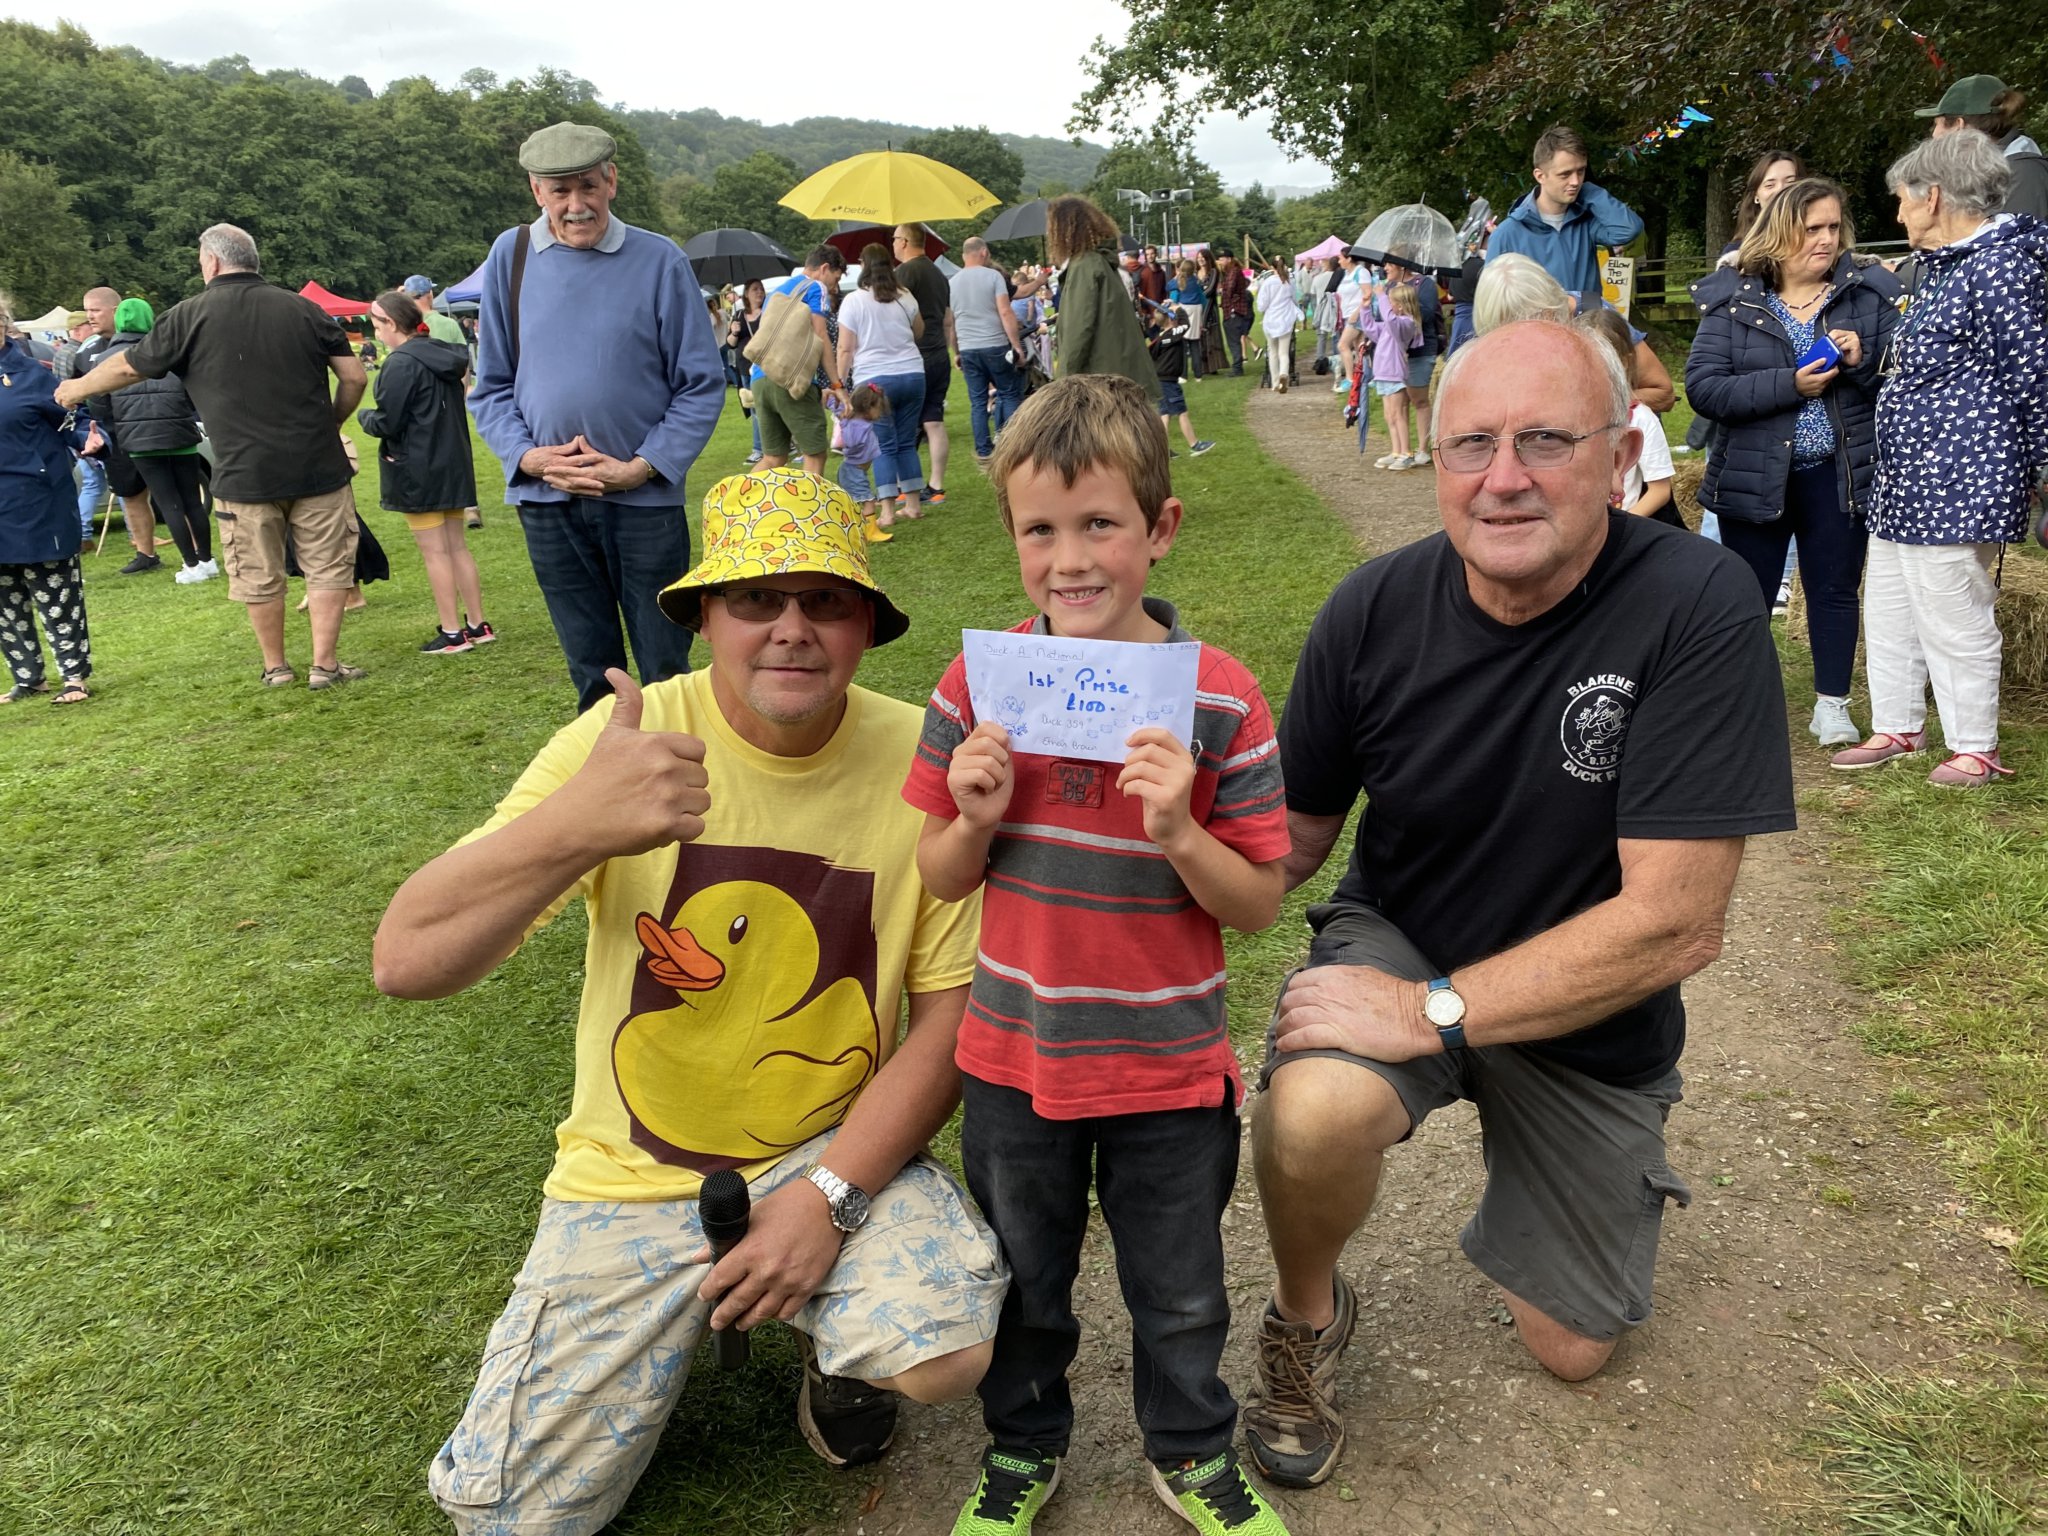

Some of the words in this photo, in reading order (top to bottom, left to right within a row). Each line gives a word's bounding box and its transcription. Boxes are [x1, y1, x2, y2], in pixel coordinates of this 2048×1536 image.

[843, 205, 879, 216] betfair
[1607, 268, 1622, 277] The
[983, 643, 1009, 655] Duck
[1018, 645, 1026, 655] A
[1036, 648, 1084, 661] National
[1028, 671, 1055, 688] 1st
[1562, 760, 1602, 782] DUCK
[990, 1454, 1037, 1471] SKECHERS
[1184, 1455, 1226, 1480] SKECHERS
